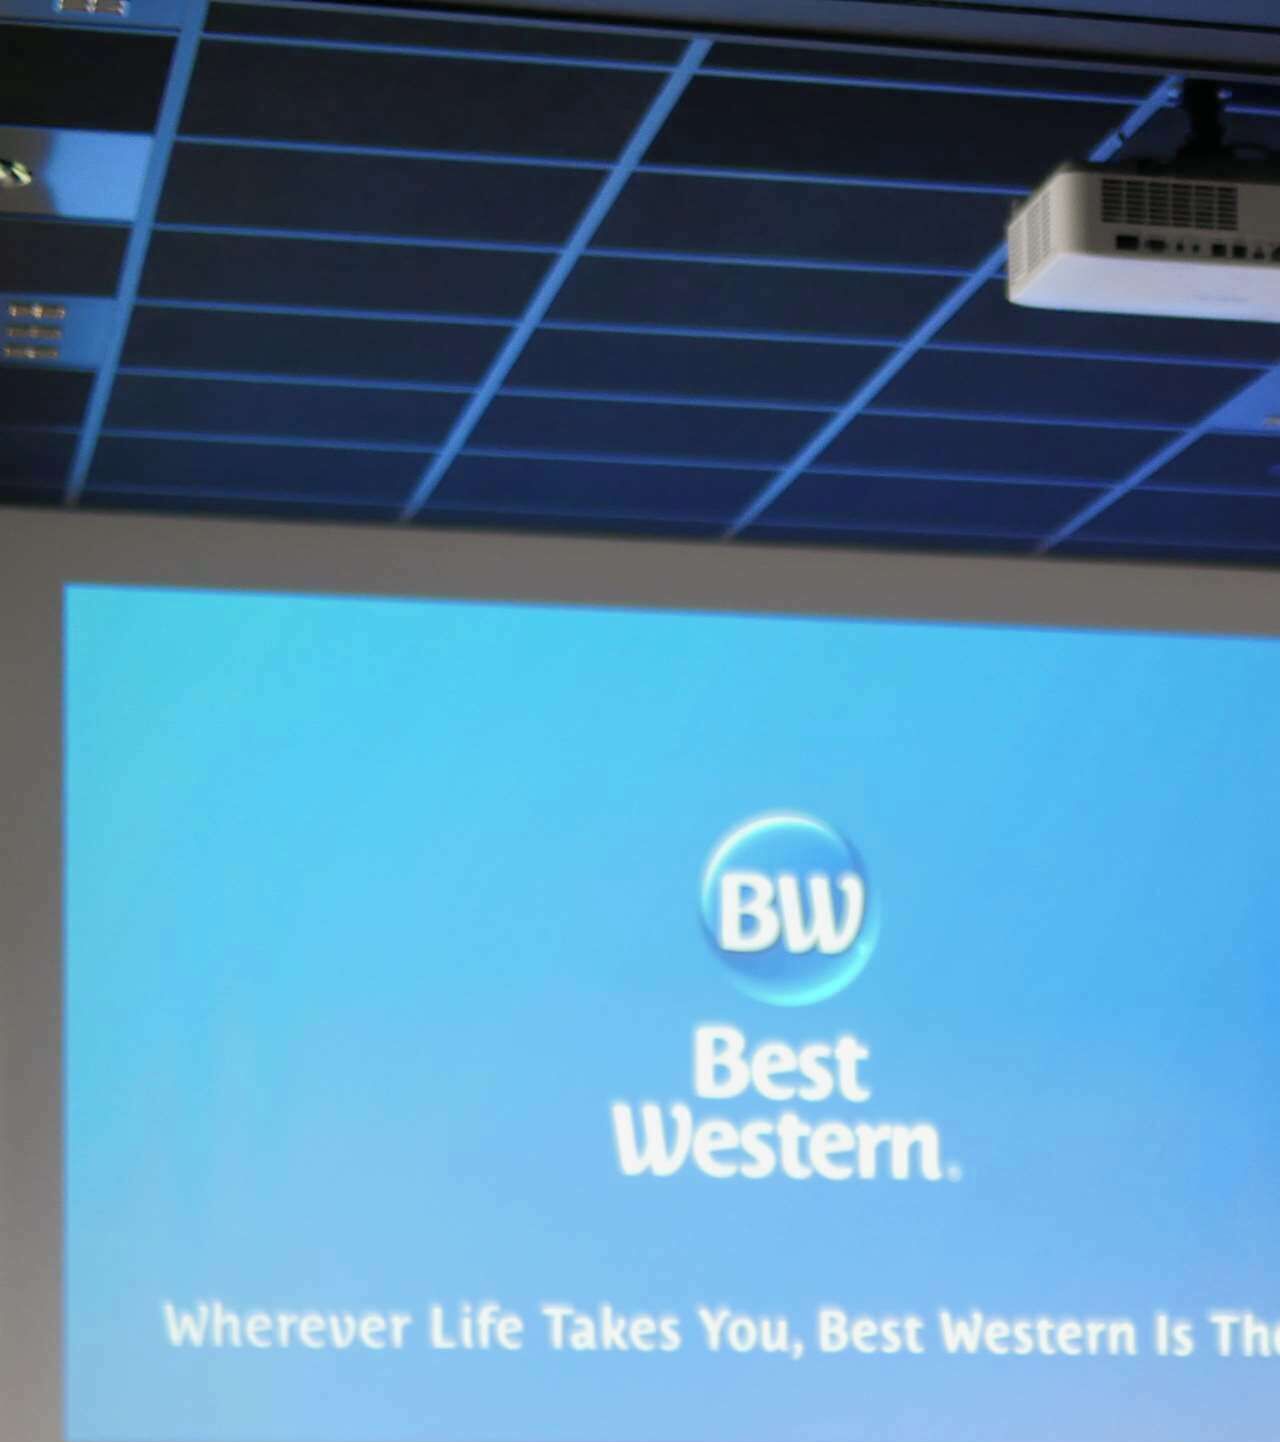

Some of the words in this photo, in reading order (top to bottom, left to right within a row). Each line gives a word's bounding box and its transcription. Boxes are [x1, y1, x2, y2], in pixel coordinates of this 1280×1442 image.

[716, 871, 866, 956] BW
[692, 1024, 872, 1103] Best
[163, 1300, 413, 1350] Wherever
[429, 1300, 524, 1352] Life
[540, 1302, 682, 1353] Takes
[697, 1304, 806, 1361] You,
[817, 1305, 925, 1355] Best
[938, 1308, 1137, 1357] Western
[1154, 1310, 1195, 1358] Is
